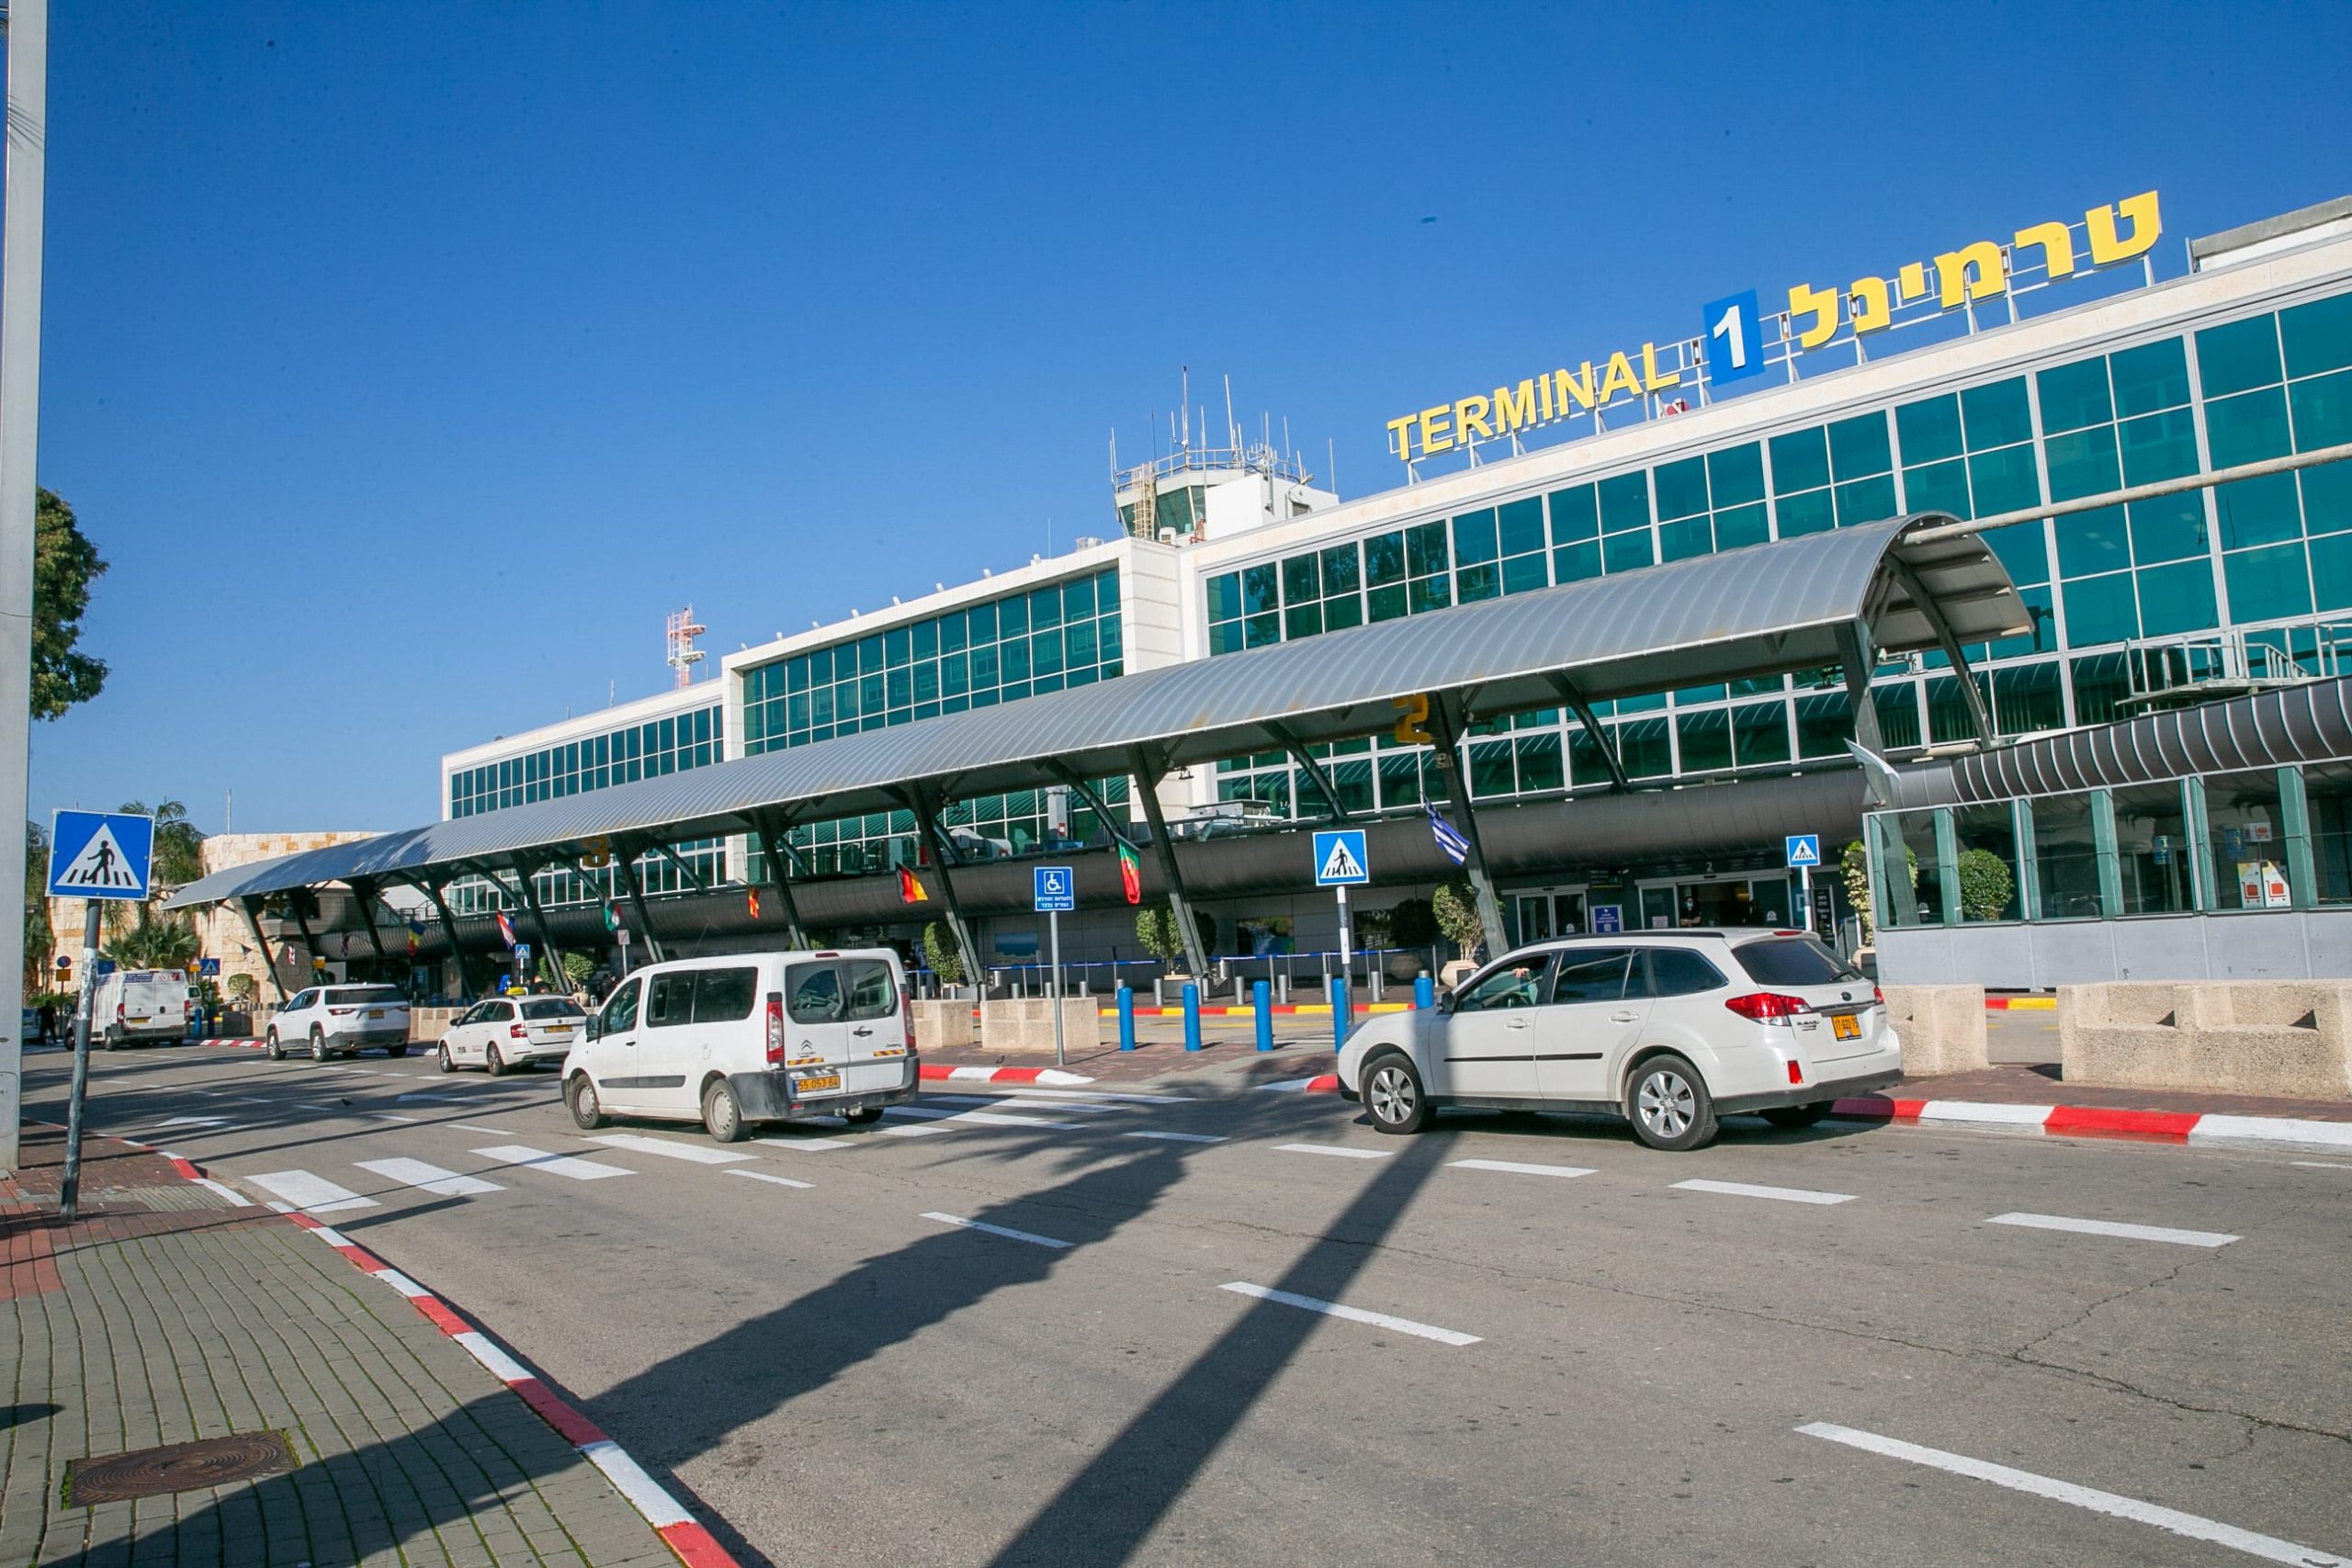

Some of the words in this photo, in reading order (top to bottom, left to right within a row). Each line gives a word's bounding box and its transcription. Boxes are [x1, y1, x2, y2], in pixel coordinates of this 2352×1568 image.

[1790, 191, 2160, 348] טרמינל
[1388, 344, 1679, 459] TERMINAL
[1713, 305, 1746, 368] 1
[1392, 694, 1431, 743] 2
